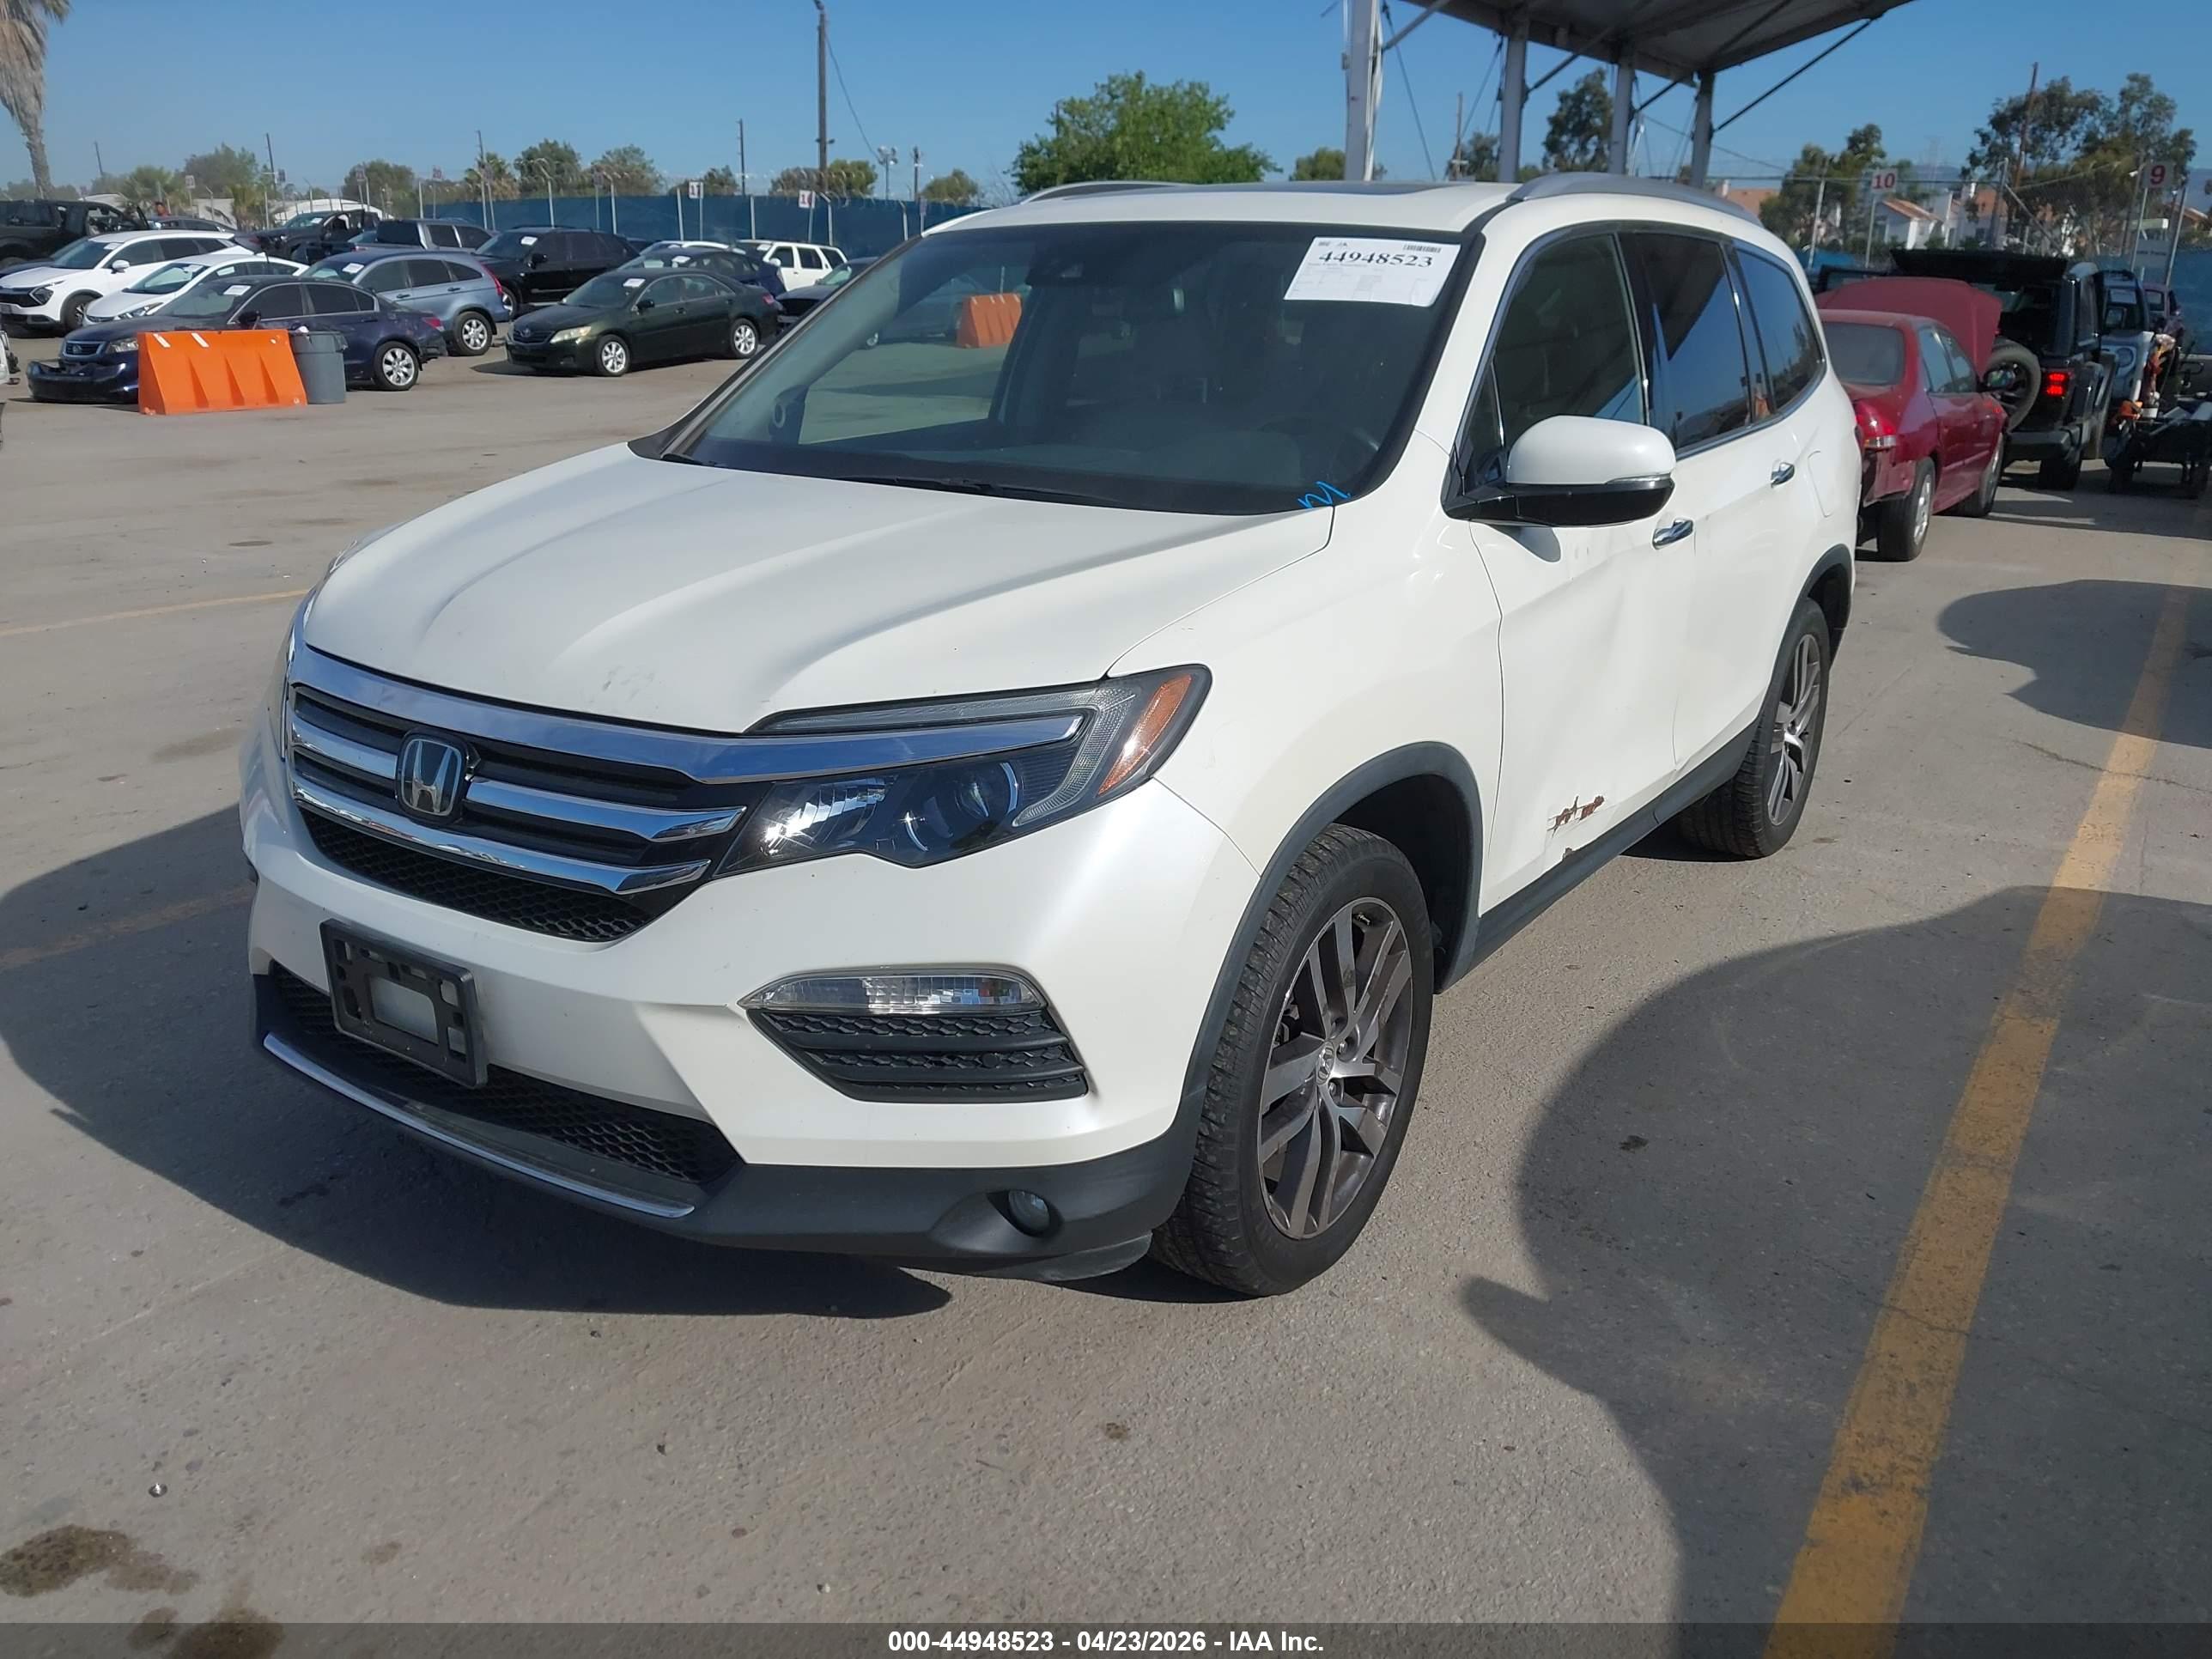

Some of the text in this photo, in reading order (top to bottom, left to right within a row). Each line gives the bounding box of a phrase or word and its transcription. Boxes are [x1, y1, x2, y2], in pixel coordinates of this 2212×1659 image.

[1873, 172, 1896, 189] 10
[2149, 164, 2166, 185] 9
[1318, 250, 1433, 269] 44948523
